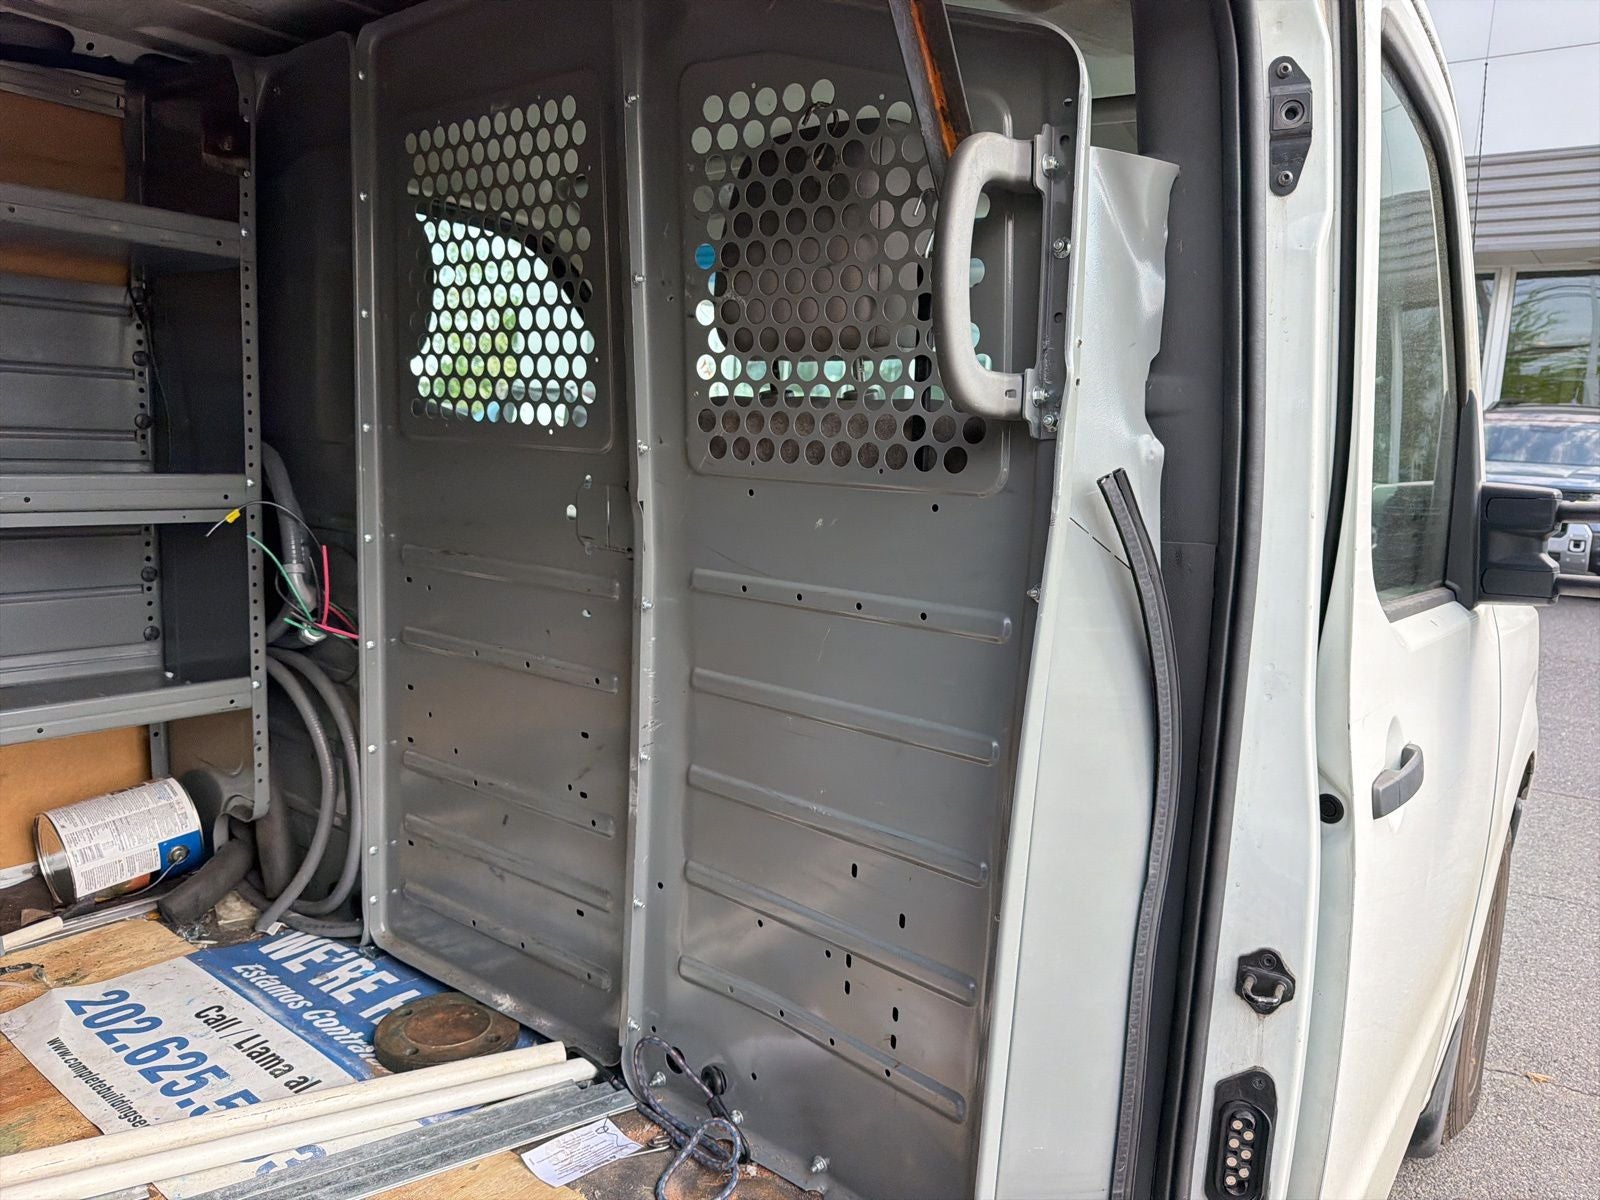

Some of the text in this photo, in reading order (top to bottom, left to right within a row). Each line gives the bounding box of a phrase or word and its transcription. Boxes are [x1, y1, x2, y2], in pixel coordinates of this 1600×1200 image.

[232, 963, 313, 1010] Estamos
[259, 931, 400, 1004] WE'RE
[194, 1005, 323, 1094] Call / Llama al
